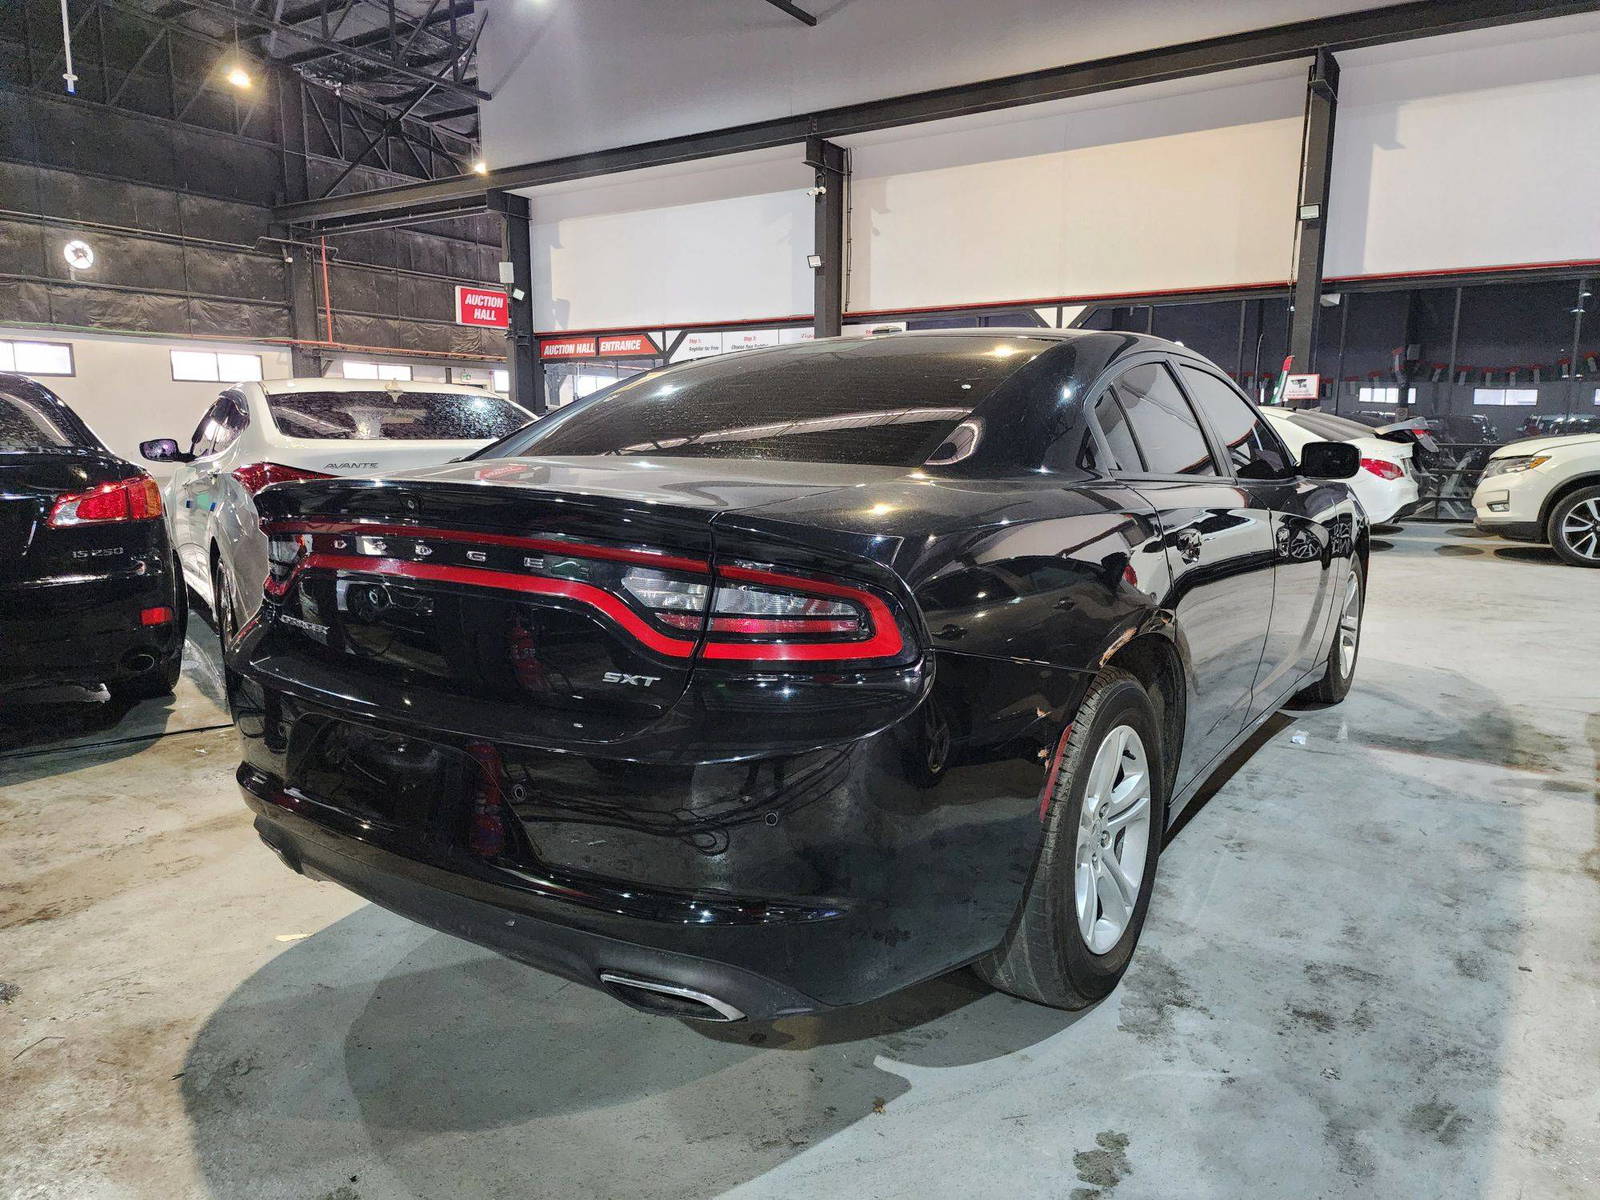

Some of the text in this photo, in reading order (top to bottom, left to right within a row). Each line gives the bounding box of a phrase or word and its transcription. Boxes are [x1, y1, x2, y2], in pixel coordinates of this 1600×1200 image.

[464, 293, 504, 309] AUCTION
[473, 308, 497, 321] HALL
[543, 339, 642, 356] AUCTION HALL ENTRANCE
[602, 671, 661, 687] SXT
